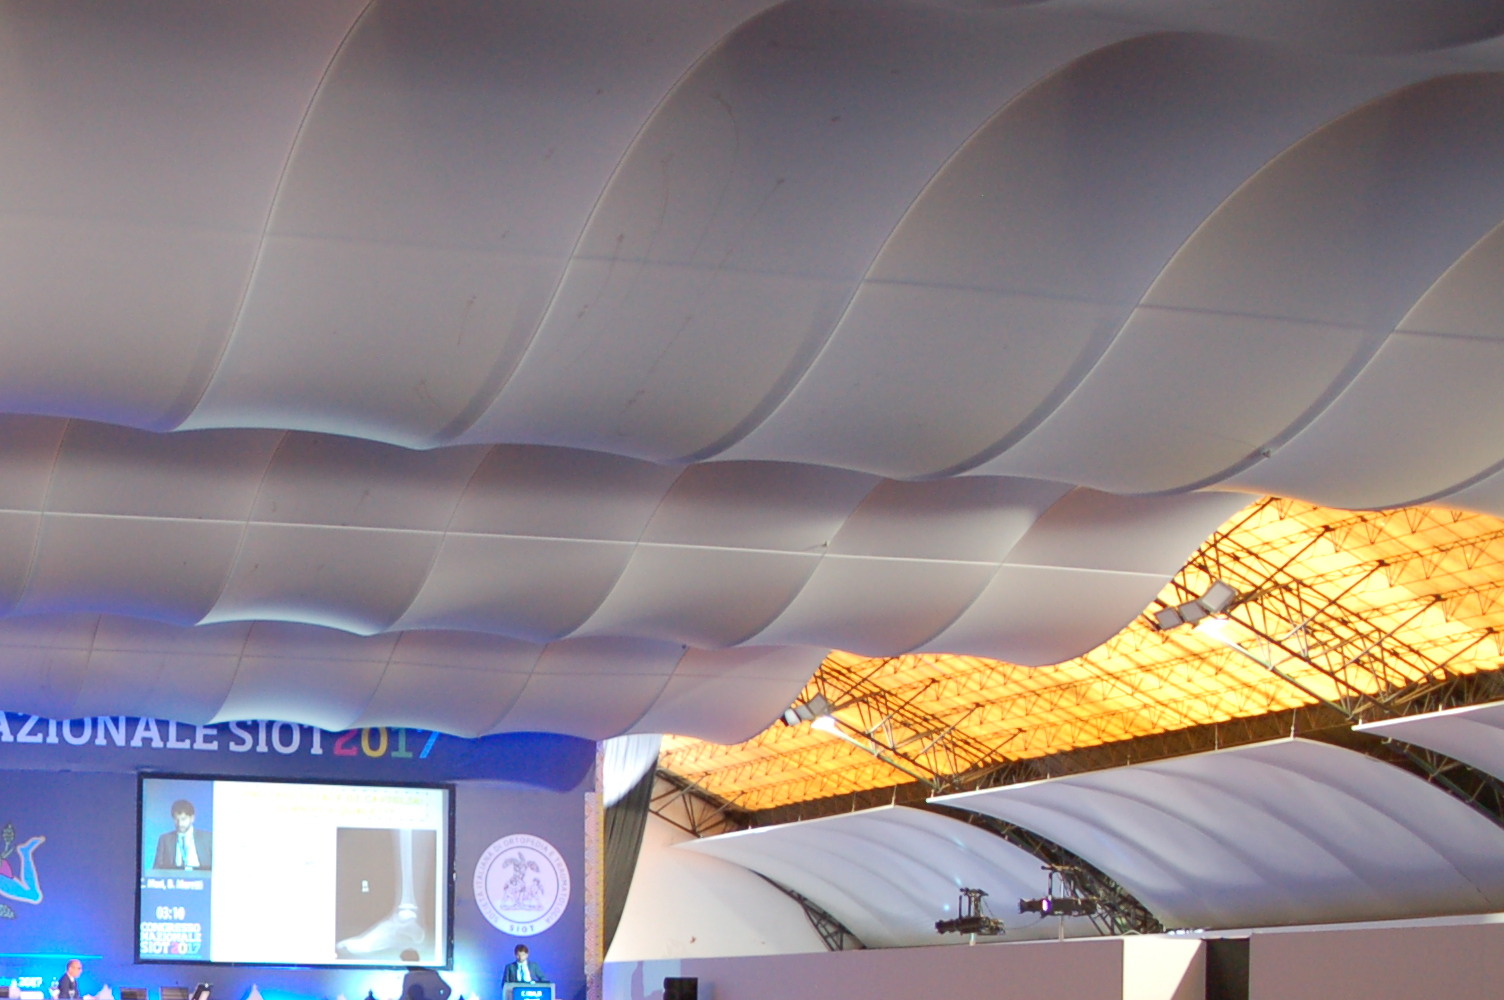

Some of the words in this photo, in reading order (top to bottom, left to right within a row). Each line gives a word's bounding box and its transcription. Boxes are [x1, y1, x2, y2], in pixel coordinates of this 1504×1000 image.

[475, 849, 495, 889] ITALIANA
[501, 835, 550, 853] ORTOPEDIA
[543, 855, 568, 926] TRAUMATOLOGIA
[156, 906, 186, 920] 03:10
[140, 922, 200, 932] CONGRESSO
[509, 924, 534, 933] SIOT
[140, 932, 201, 941] NAZIONALE
